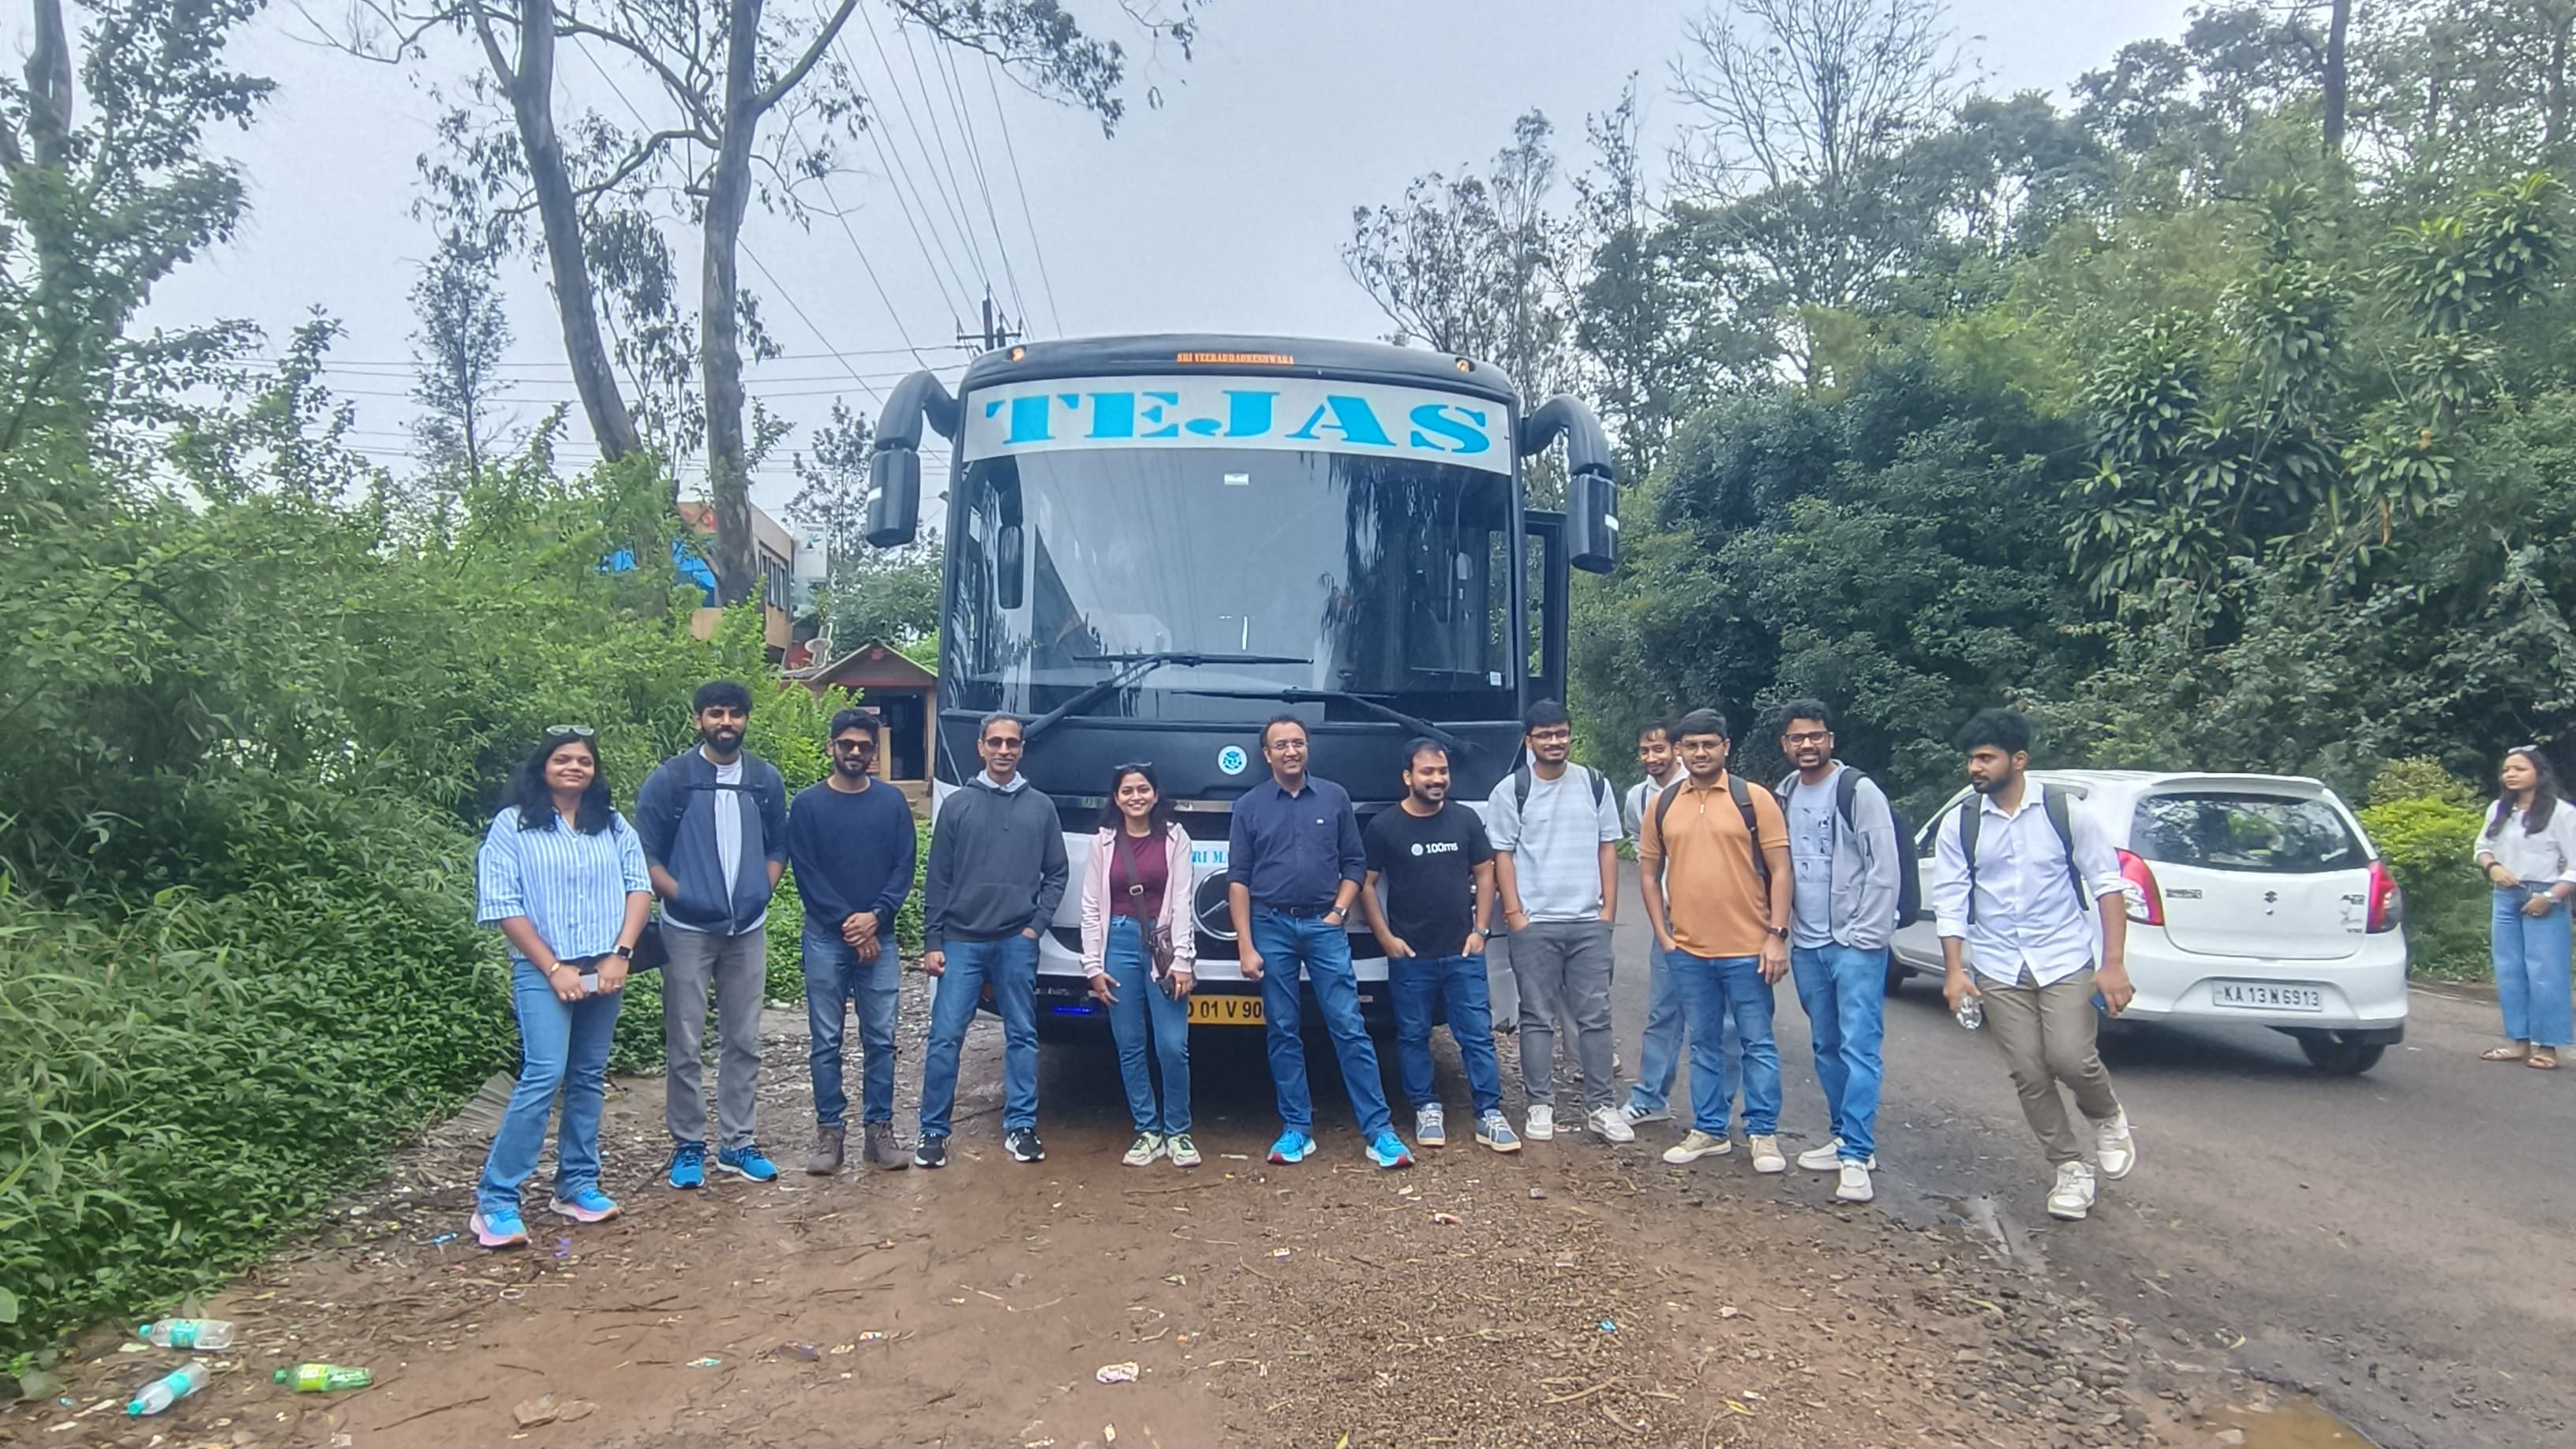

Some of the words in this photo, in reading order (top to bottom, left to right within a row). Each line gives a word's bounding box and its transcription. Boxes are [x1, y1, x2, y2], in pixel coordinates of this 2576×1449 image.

[986, 389, 1491, 455] TEJAS
[1425, 842, 1458, 853] 100ms
[1200, 1001, 1218, 1018] 01
[1226, 1001, 1237, 1018] V
[1242, 1001, 1263, 1018] 90
